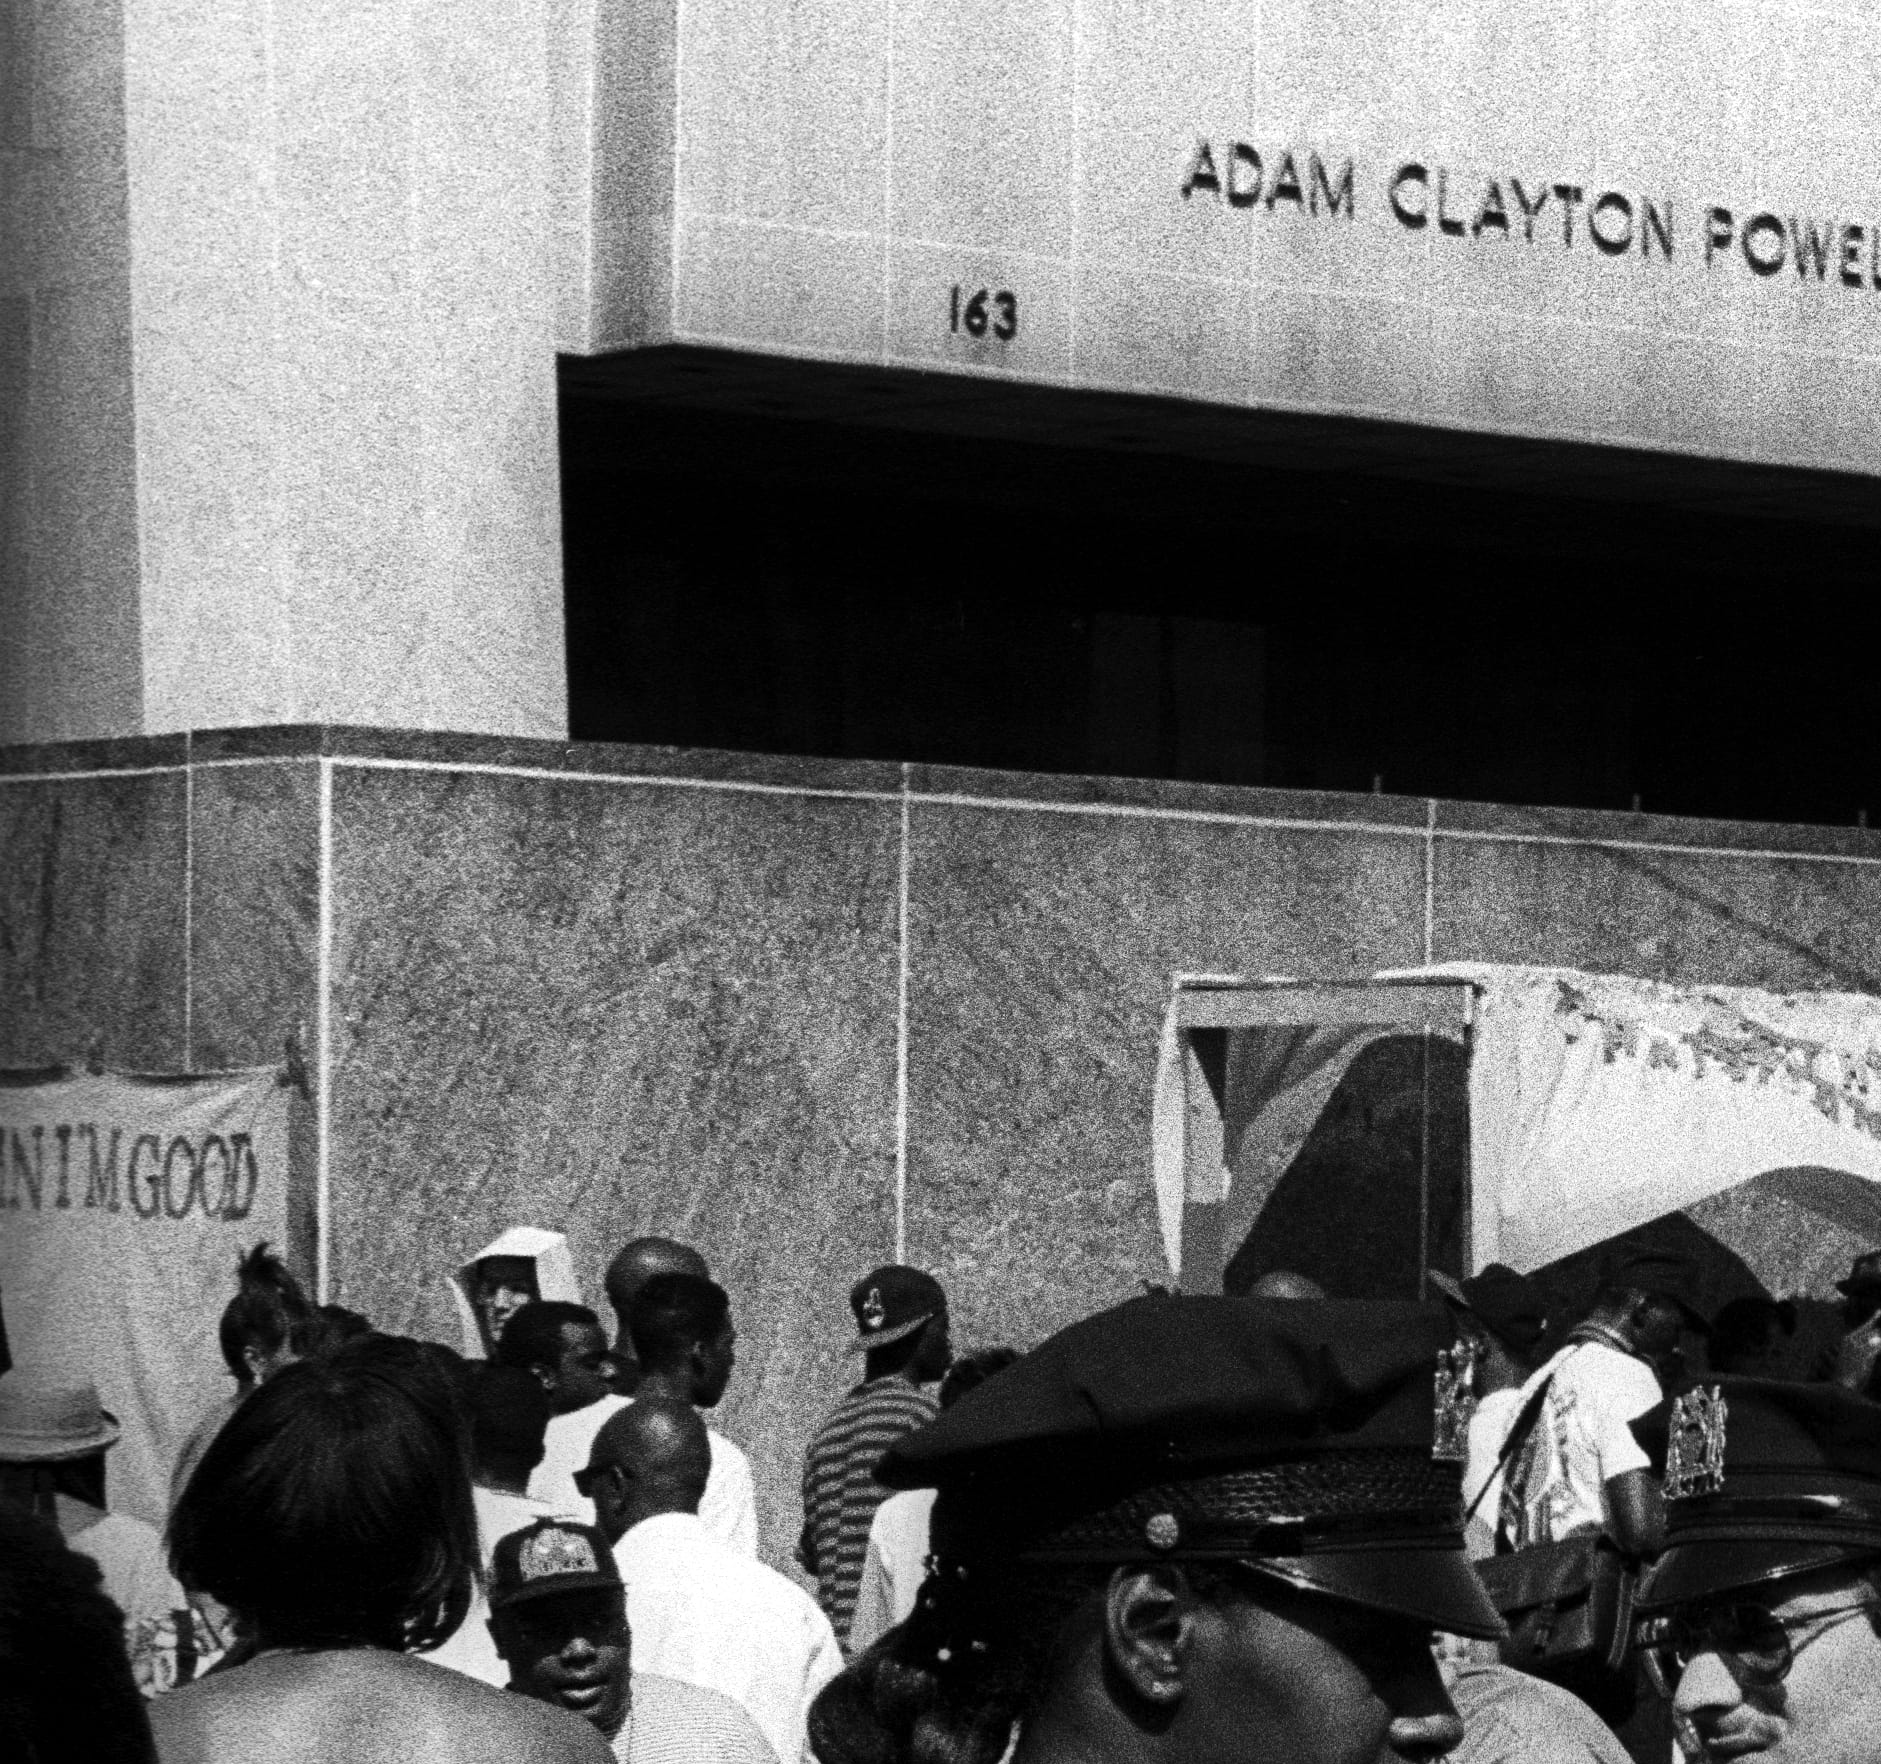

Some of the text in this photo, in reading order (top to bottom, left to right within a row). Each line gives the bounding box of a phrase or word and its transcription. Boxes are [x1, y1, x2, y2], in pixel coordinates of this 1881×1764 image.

[1180, 141, 1355, 219] ADAM
[1389, 162, 1674, 262] CLAYTON
[950, 284, 1017, 341] 163
